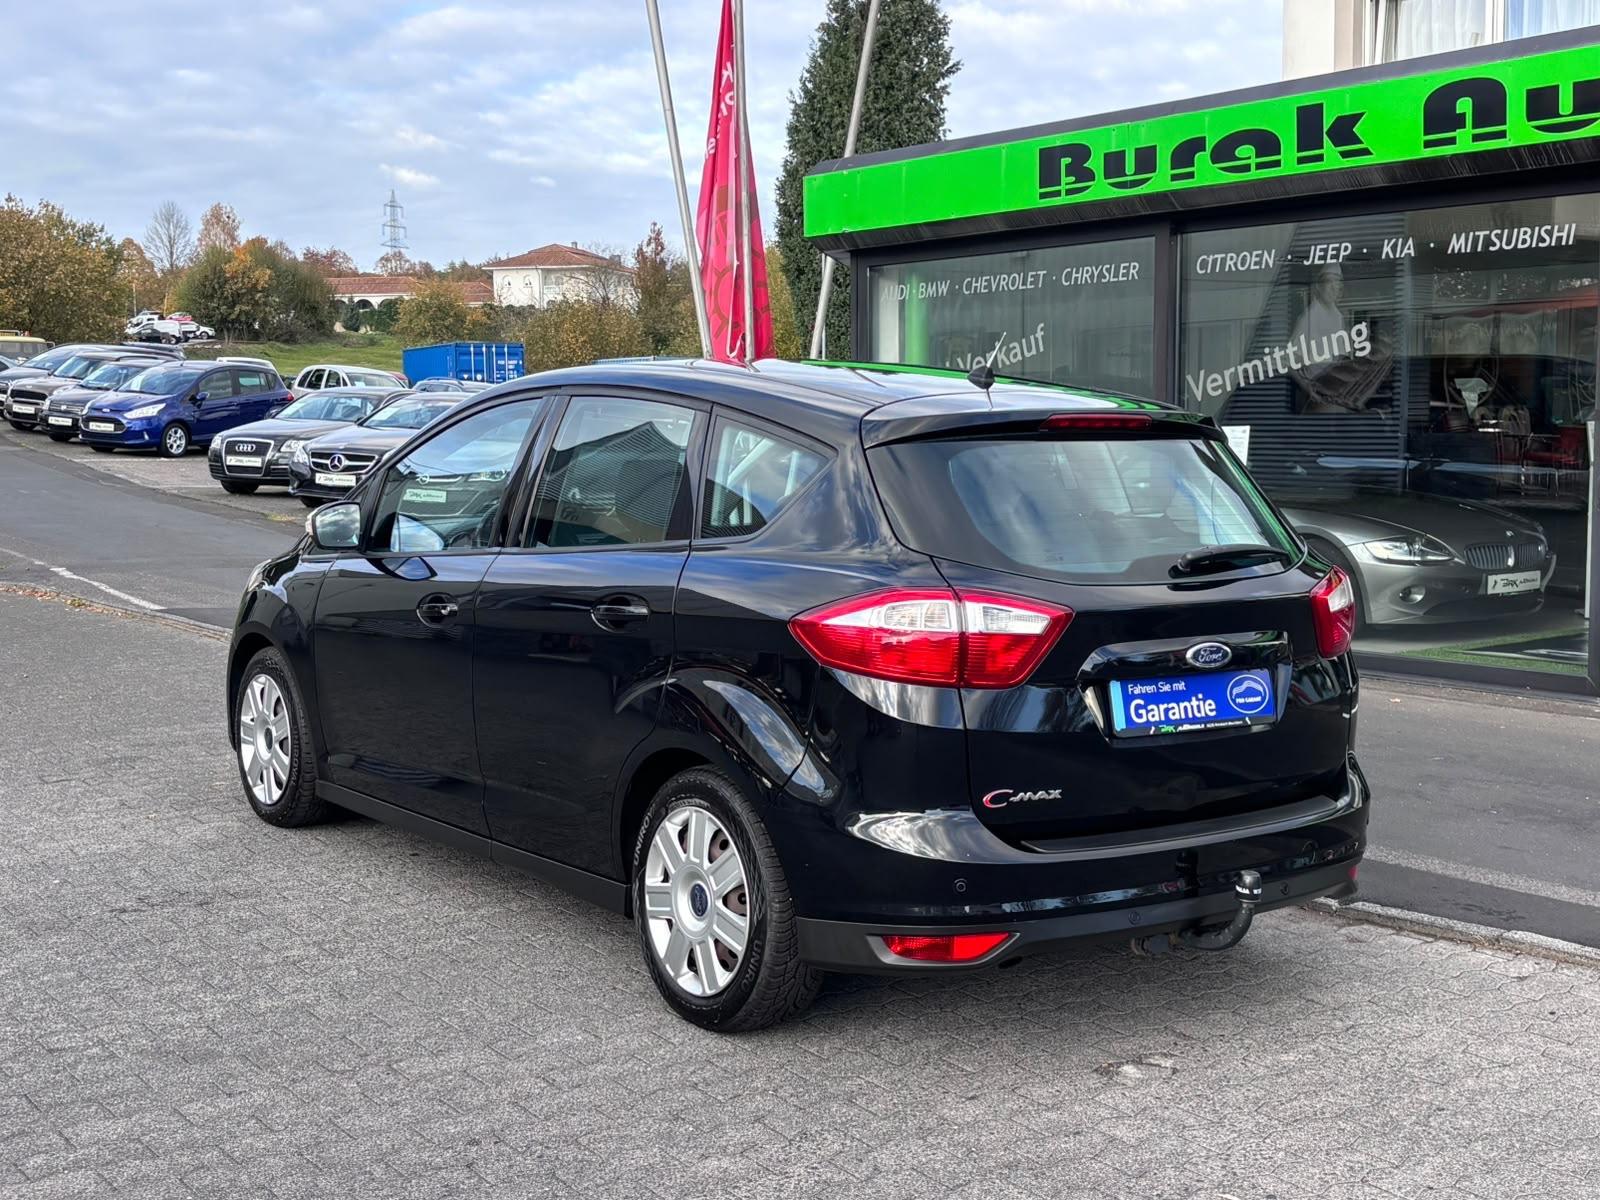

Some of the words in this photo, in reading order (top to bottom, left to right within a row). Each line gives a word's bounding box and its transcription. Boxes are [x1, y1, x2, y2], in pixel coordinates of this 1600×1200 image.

[1038, 102, 1374, 200] Burak
[1195, 248, 1276, 274] CITROEN
[1303, 242, 1352, 266] JEEP
[1381, 237, 1416, 260] KIA
[1447, 223, 1577, 254] MITSUBISHI
[881, 284, 910, 301] AUDI
[918, 280, 950, 299] BMW
[962, 270, 1047, 295] CHEVROLET
[1061, 261, 1140, 286] CHRYSLER
[1186, 320, 1372, 402] Vermittlung
[1198, 647, 1224, 664] Ford
[1127, 683, 1157, 695] Fahren
[1157, 681, 1172, 693] Sie
[1172, 680, 1186, 691] mit
[1129, 693, 1217, 723] Garantie
